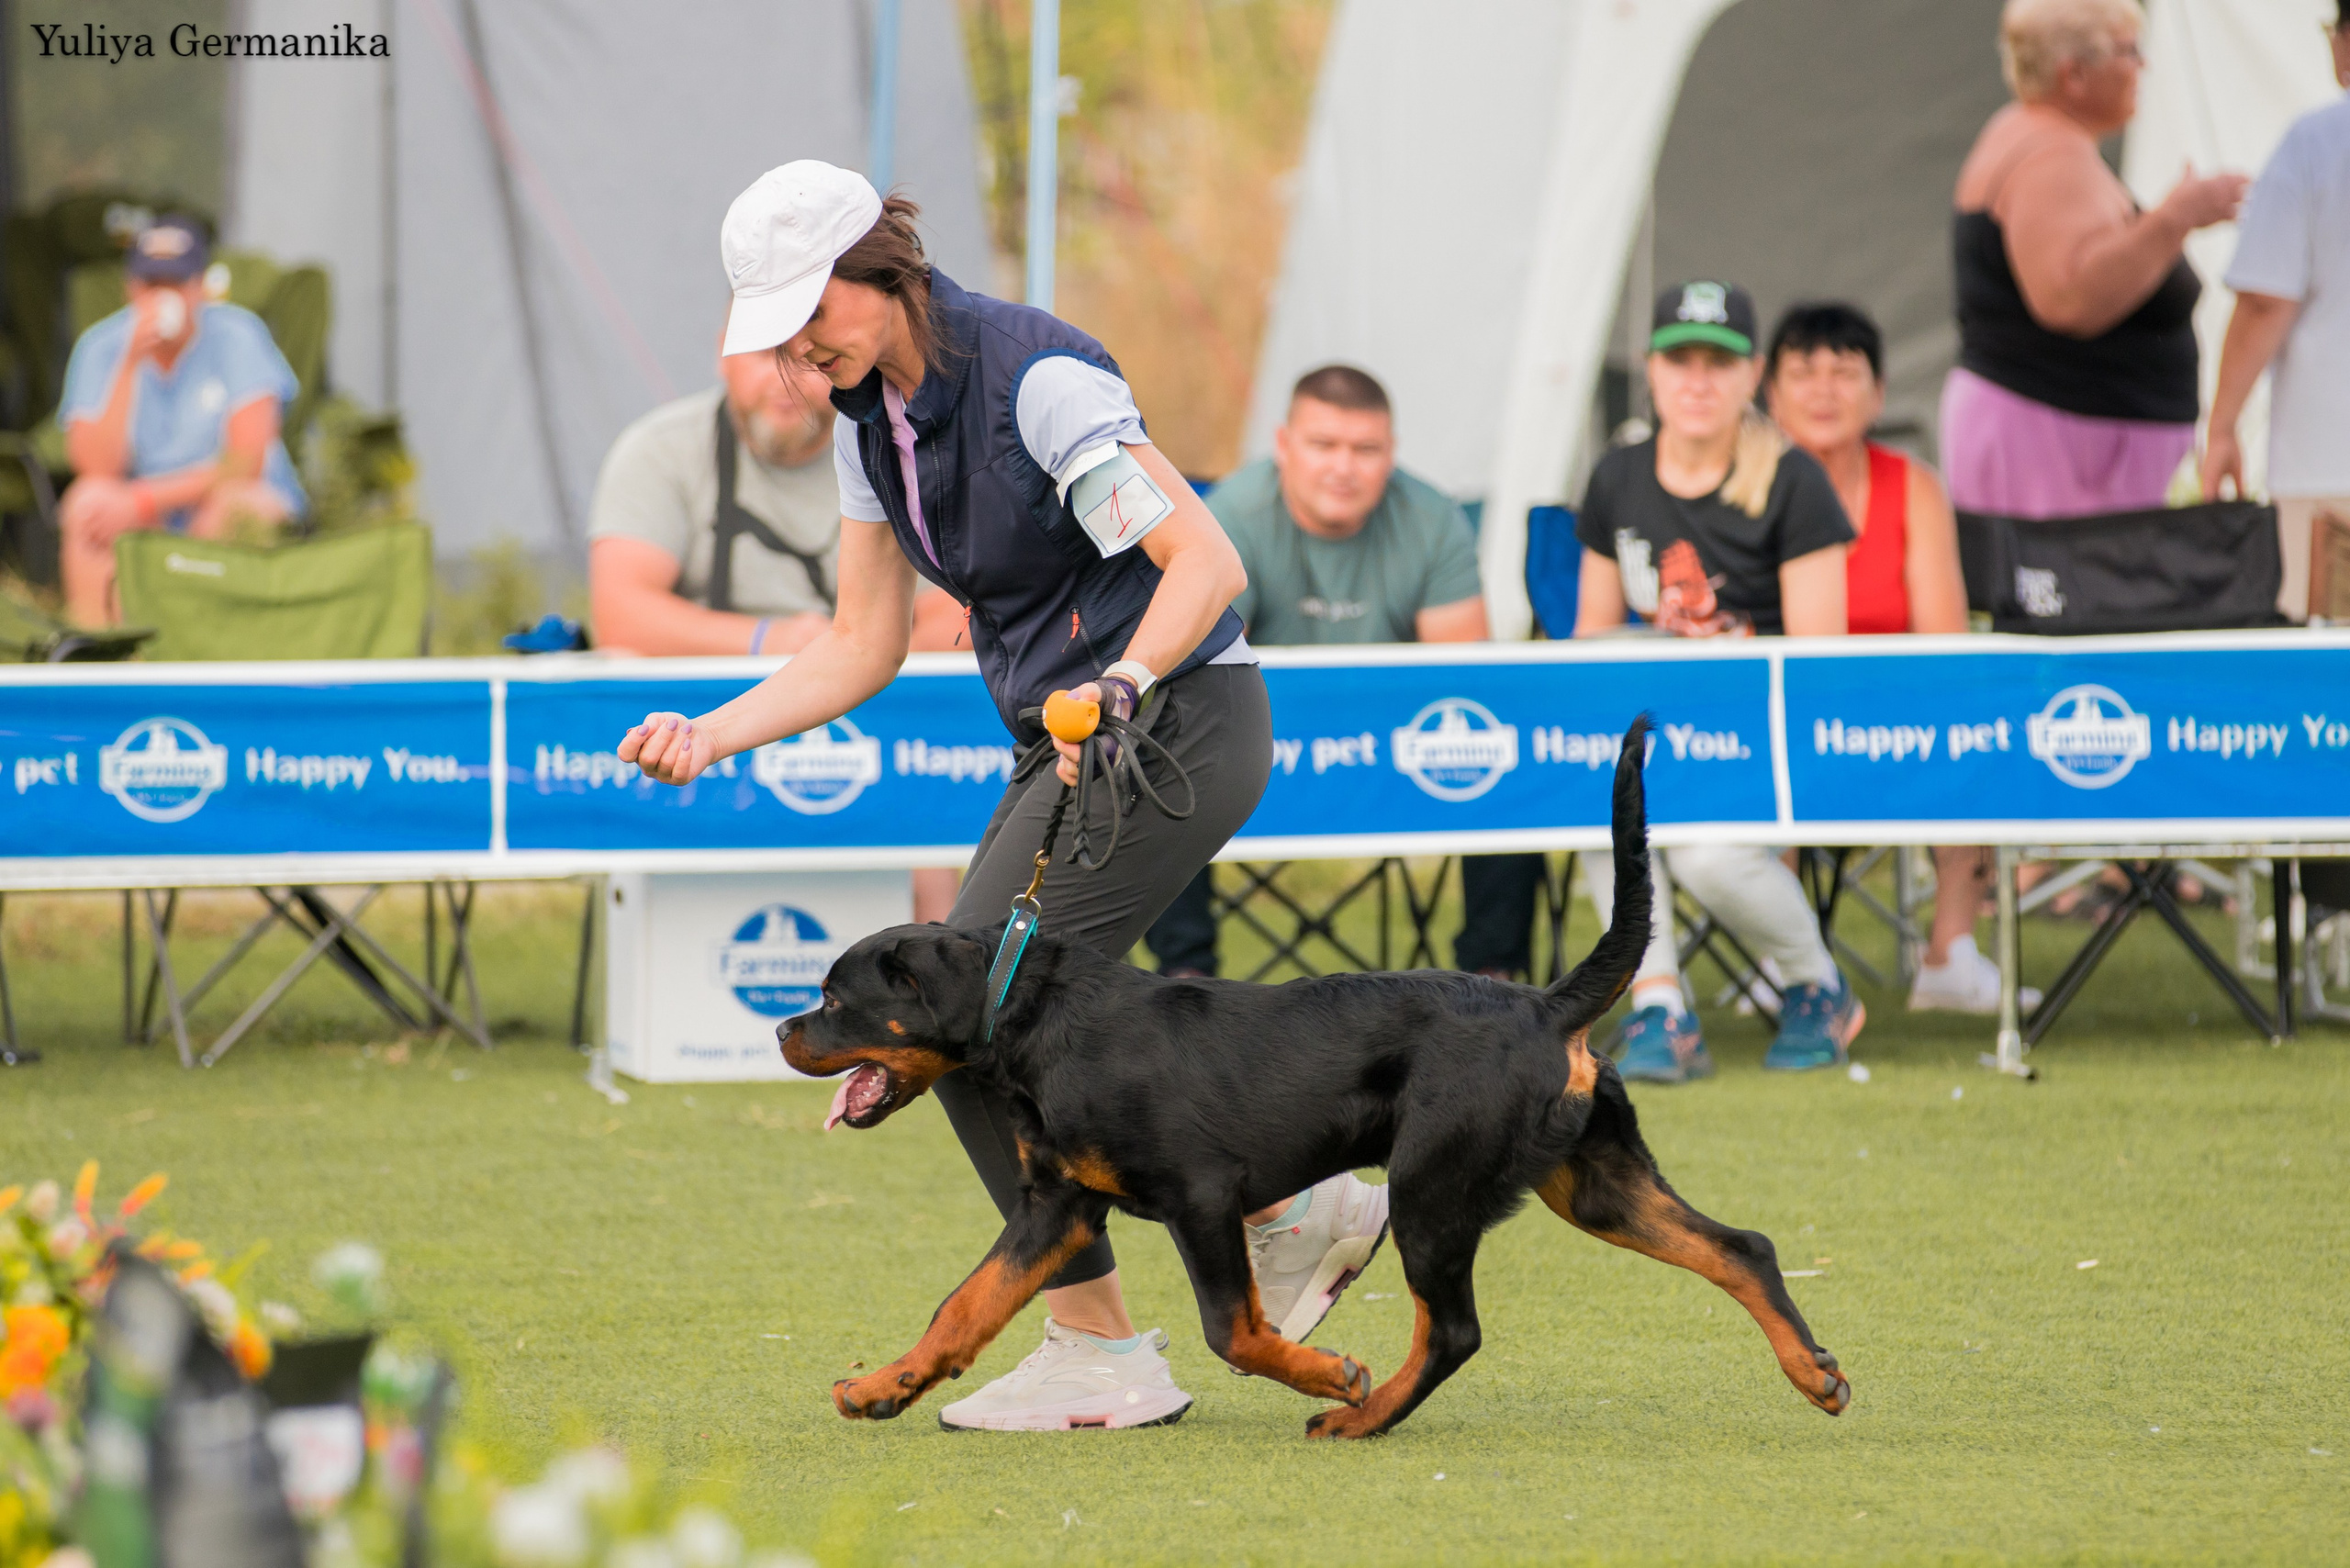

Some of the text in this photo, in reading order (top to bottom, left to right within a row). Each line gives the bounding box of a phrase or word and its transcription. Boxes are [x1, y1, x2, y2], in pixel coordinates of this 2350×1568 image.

[1311, 732, 1377, 774] pet
[1663, 723, 1752, 761] You.
[1813, 719, 1936, 762] Happy
[1948, 717, 2011, 761] pet
[2167, 716, 2288, 759] Happy
[2302, 714, 2350, 748] Yo
[14, 751, 79, 795] pet
[245, 746, 372, 790] Happy
[383, 745, 470, 783] You.
[535, 743, 655, 789] Happ
